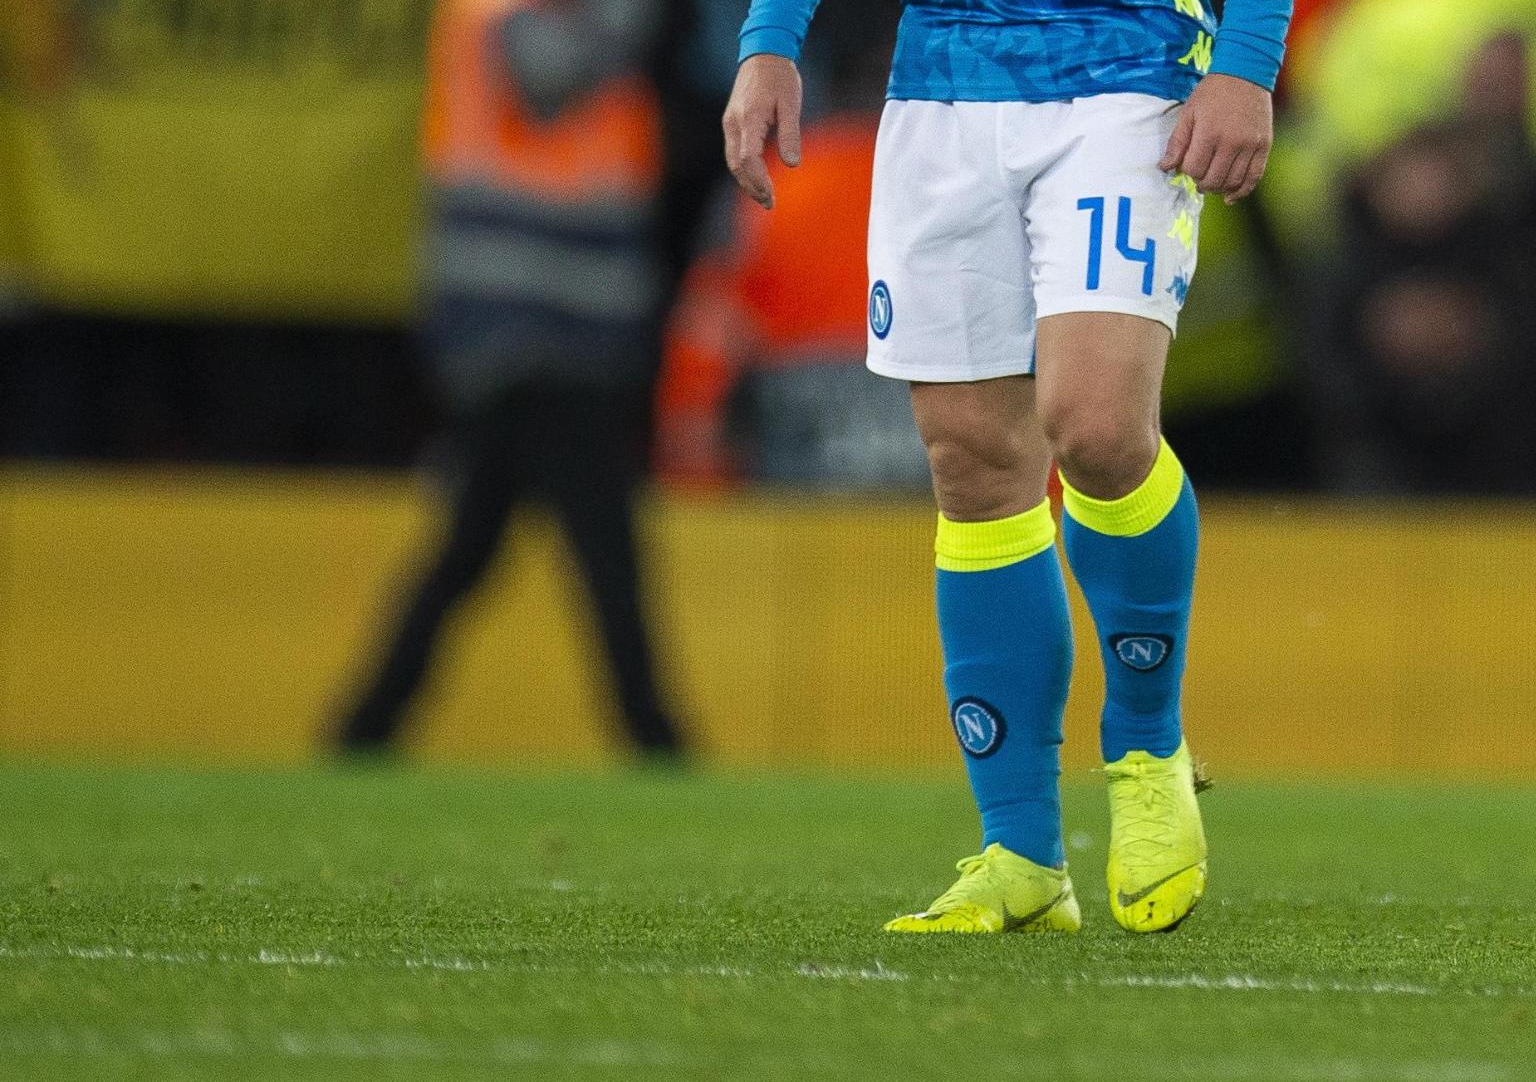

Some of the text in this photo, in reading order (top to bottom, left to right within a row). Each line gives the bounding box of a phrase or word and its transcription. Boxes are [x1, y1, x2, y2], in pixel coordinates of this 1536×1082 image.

[1077, 196, 1155, 296] 14
[1129, 642, 1153, 661] N
[960, 713, 985, 742] N
